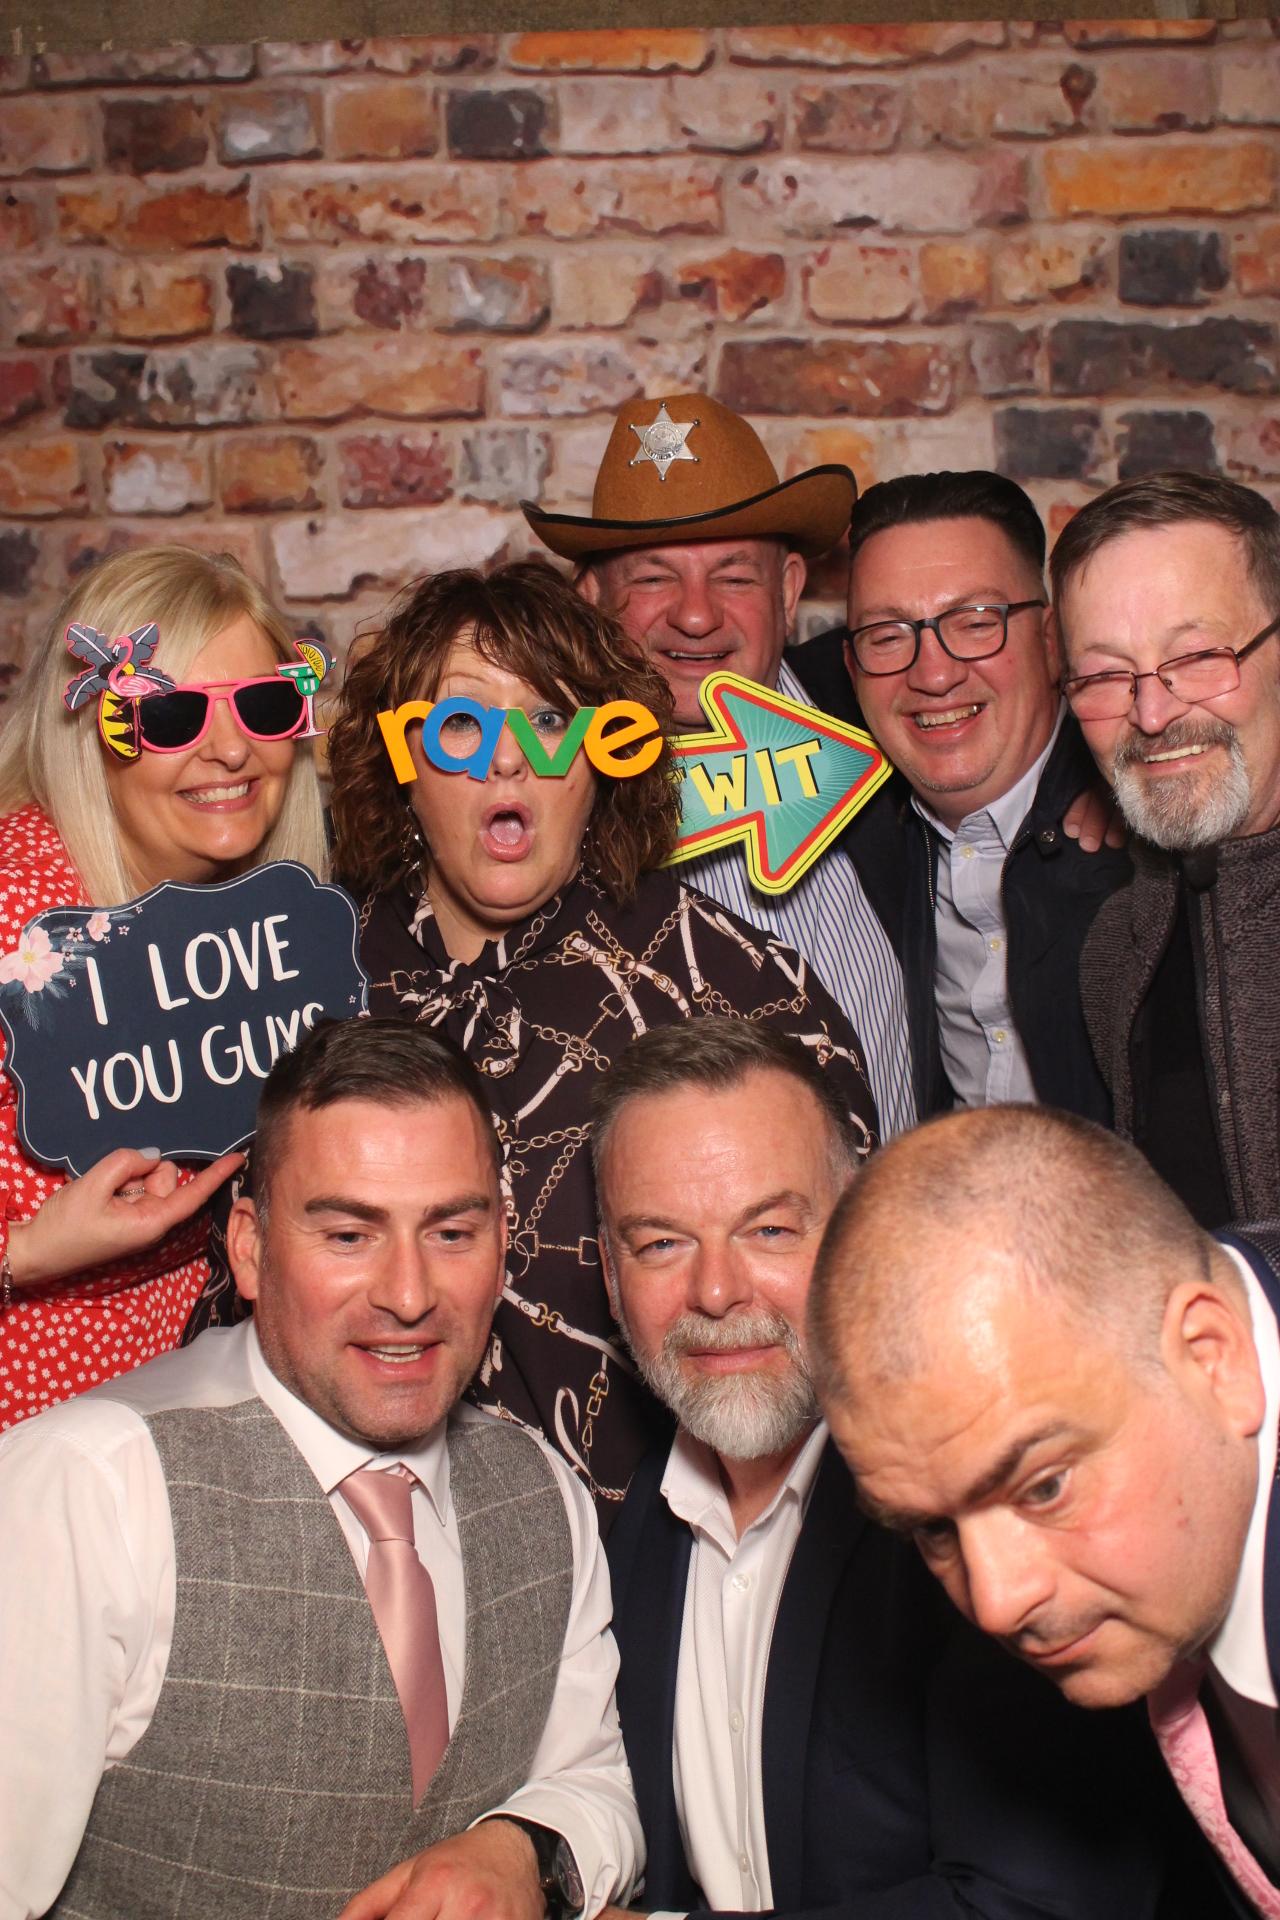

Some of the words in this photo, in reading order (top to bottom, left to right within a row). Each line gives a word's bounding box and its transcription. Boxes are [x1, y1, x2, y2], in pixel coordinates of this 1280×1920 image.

[377, 696, 663, 785] rave
[86, 956, 109, 1025] I
[148, 914, 299, 1011] LOVE
[71, 1039, 183, 1119] YOU
